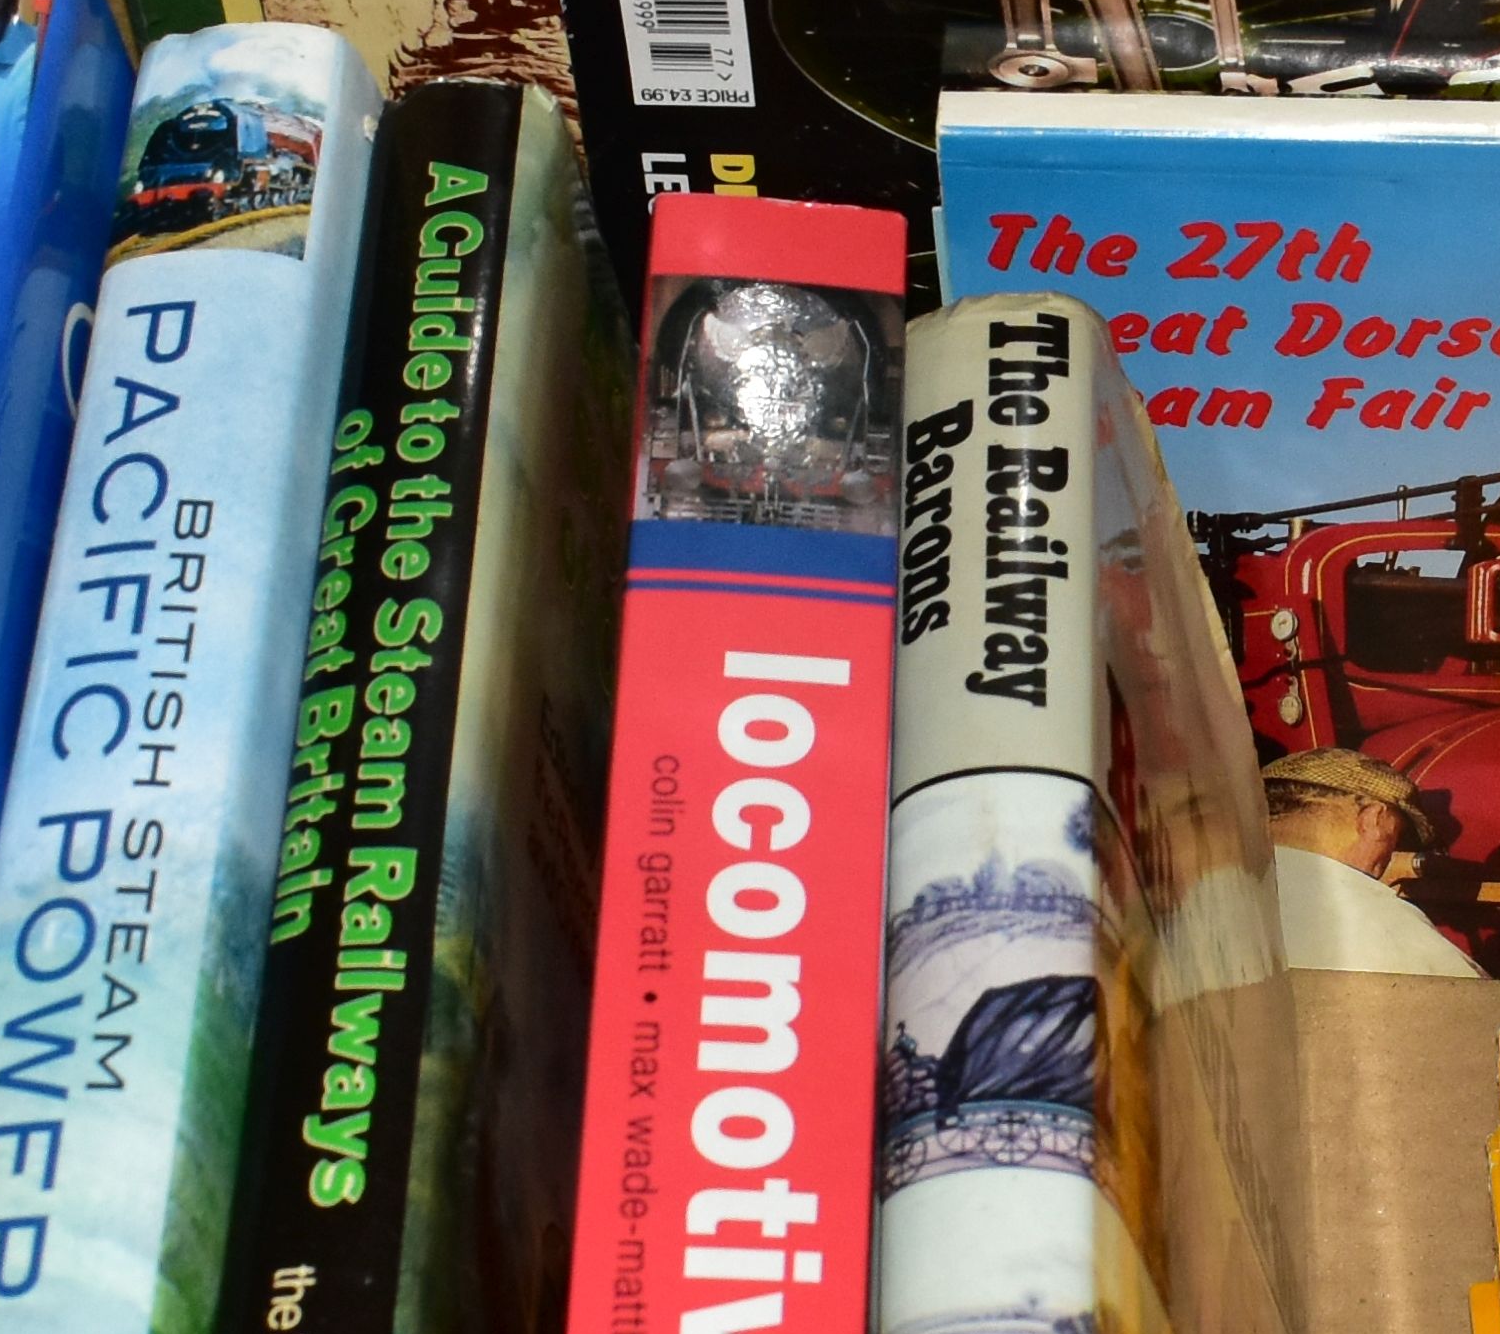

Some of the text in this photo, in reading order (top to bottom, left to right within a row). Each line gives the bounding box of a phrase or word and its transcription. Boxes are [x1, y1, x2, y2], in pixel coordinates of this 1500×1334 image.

[641, 88, 751, 104] PRICE £4.99
[987, 213, 1373, 283] The 27th
[1305, 376, 1492, 431] Fair
[51, 299, 196, 762] PACIFIC
[900, 398, 975, 647] Barons
[964, 312, 1070, 708] The Railway
[269, 408, 386, 946] of Great Britain
[302, 160, 489, 1210] A Guide to the Steam Railways
[85, 498, 215, 1092] BRITISH STEAM
[648, 752, 681, 838] colin
[636, 850, 674, 974] garratt
[628, 1018, 662, 1099] max
[265, 1263, 316, 1331] the
